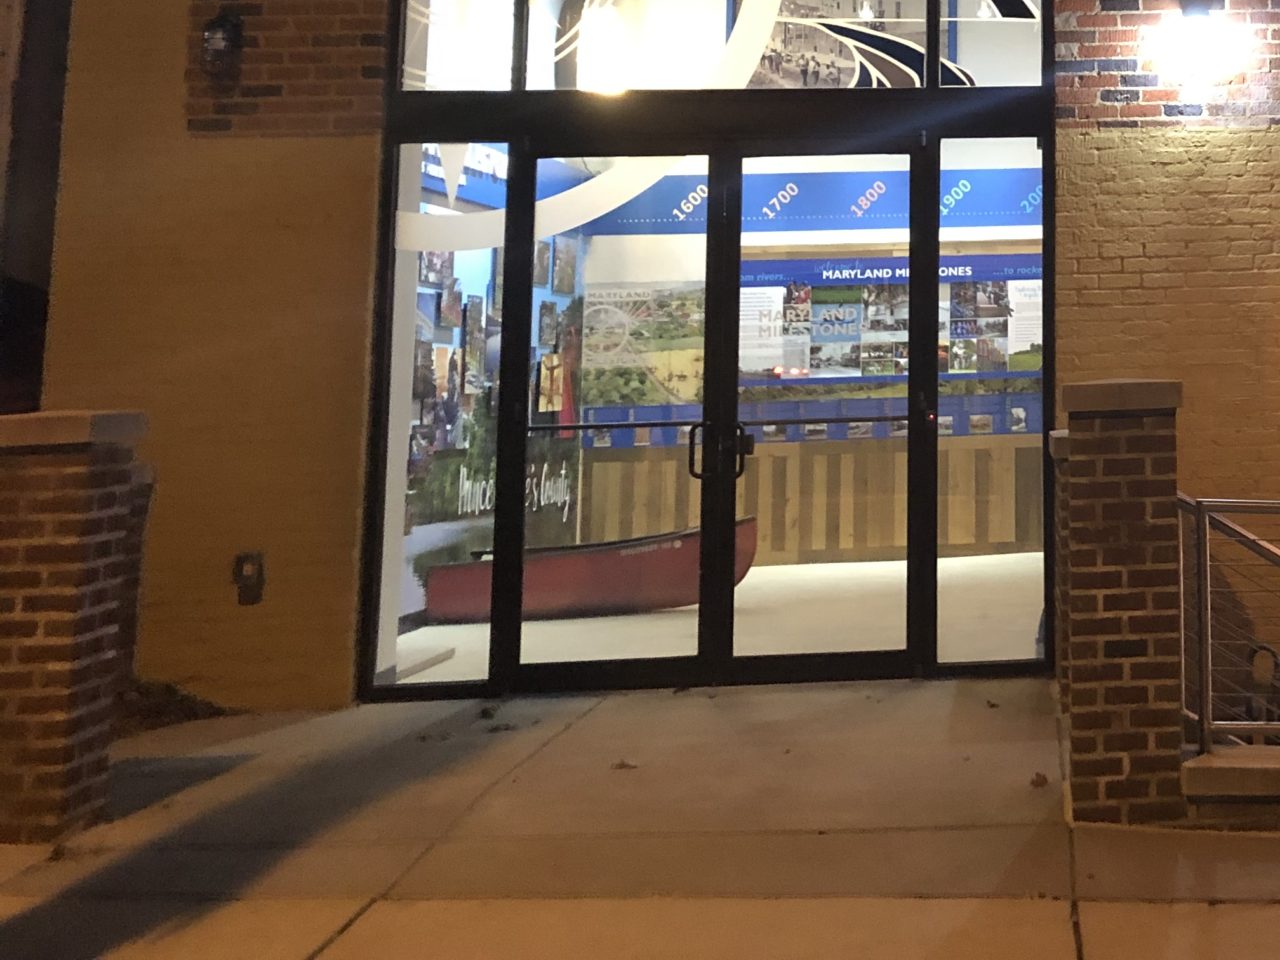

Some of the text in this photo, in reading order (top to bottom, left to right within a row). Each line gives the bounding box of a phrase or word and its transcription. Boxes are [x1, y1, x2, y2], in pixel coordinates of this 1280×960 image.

[672, 183, 708, 221] 1600
[762, 182, 799, 219] 1700
[850, 180, 886, 218] 1800
[940, 179, 972, 216] 1900
[822, 268, 893, 280] MARYLAND
[588, 290, 650, 299] MARYLAND
[758, 306, 857, 322] MARYLAND
[758, 322, 871, 338] MILESTONES
